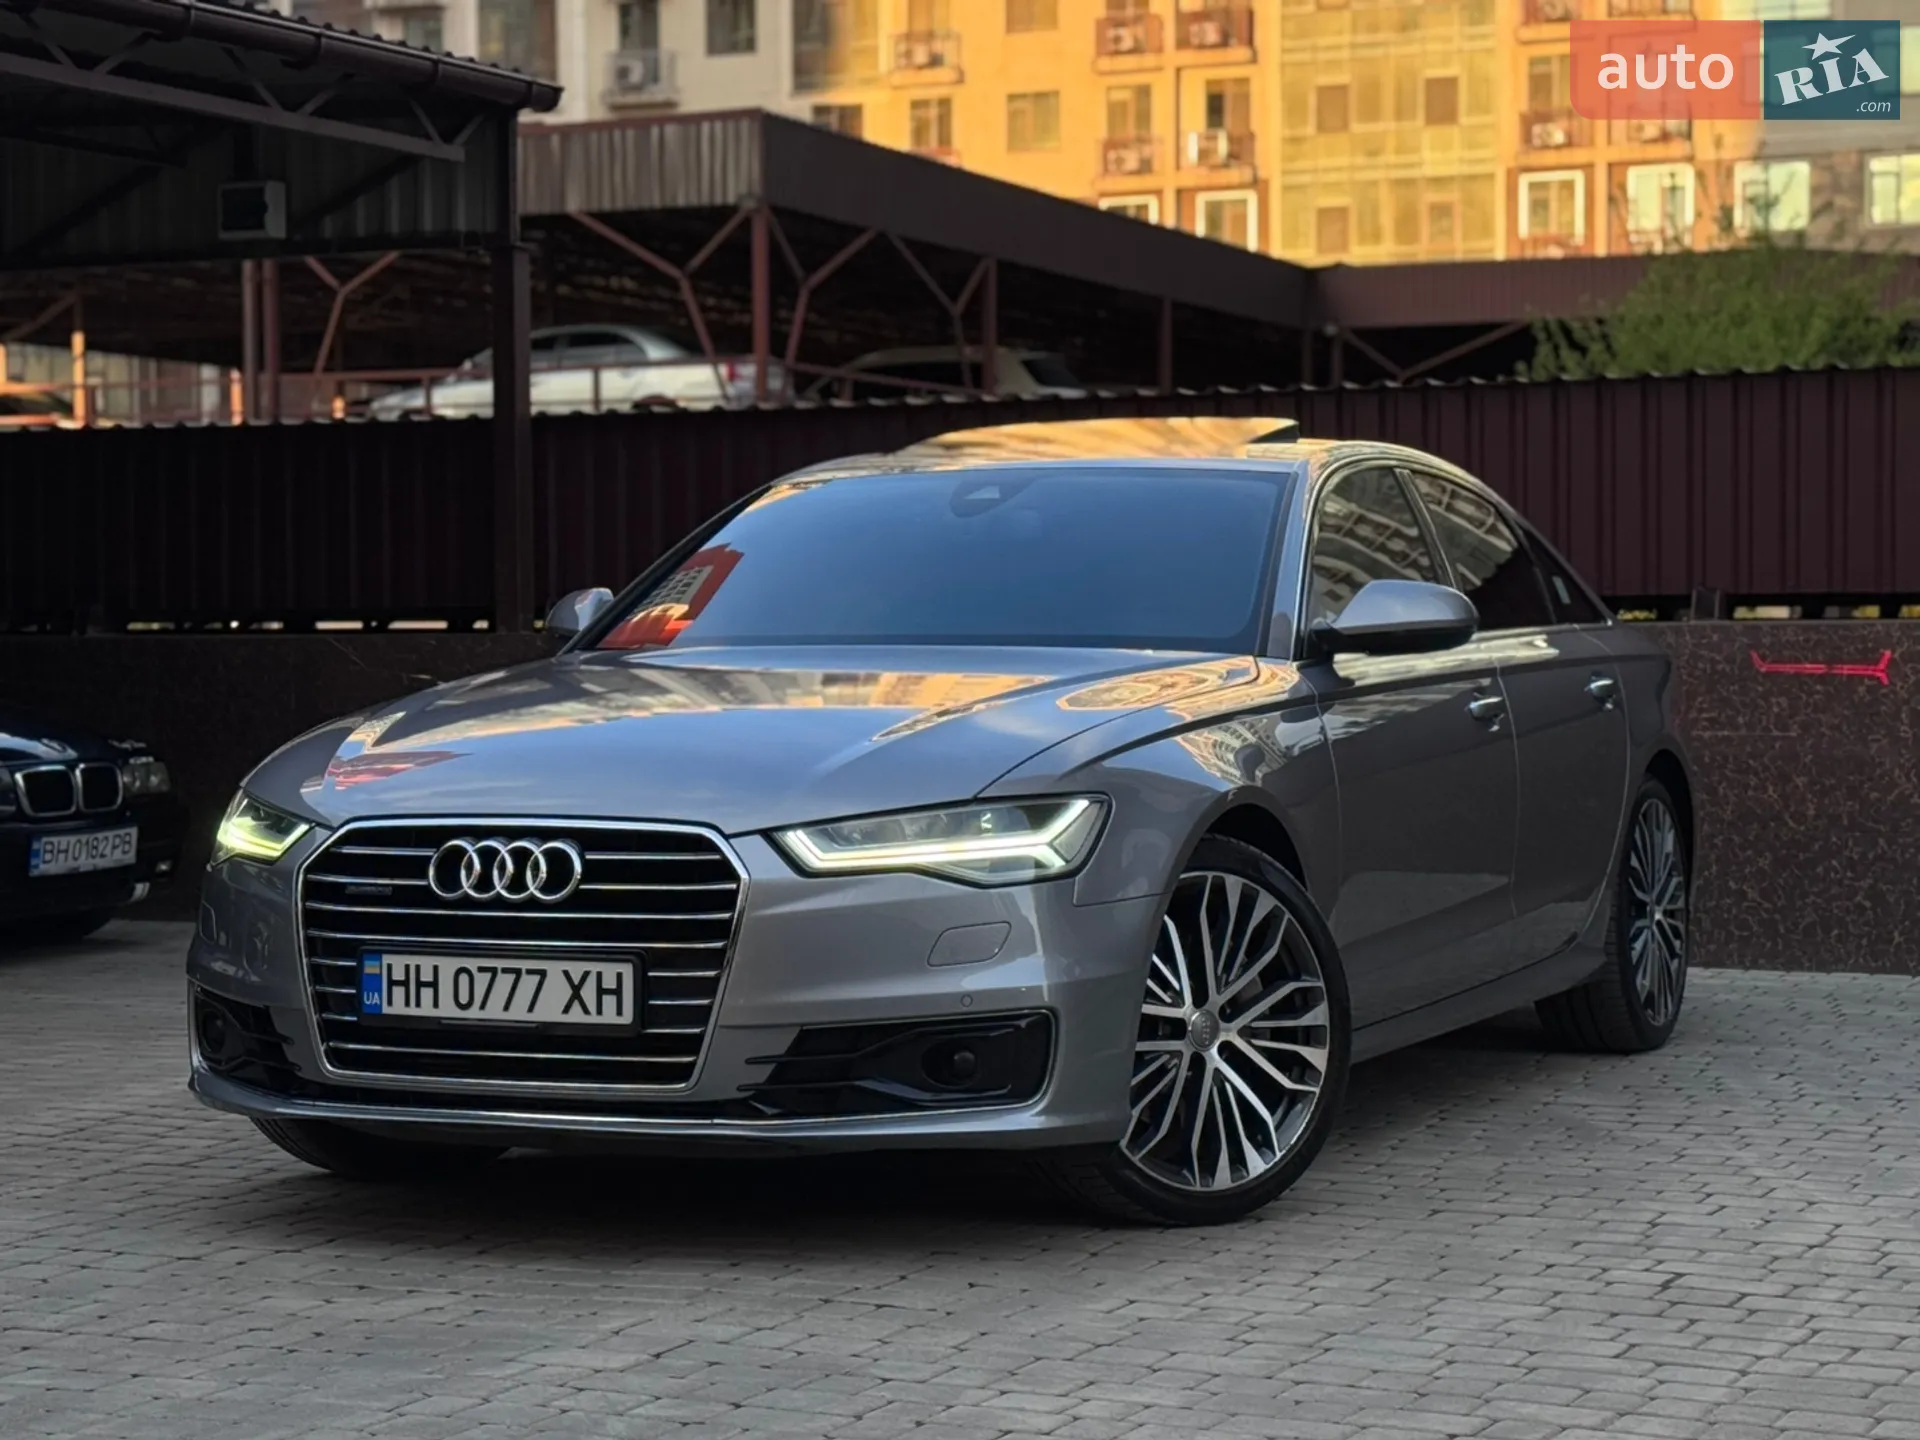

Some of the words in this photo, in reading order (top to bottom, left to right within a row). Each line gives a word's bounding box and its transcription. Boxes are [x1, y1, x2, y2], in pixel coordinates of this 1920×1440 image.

[363, 991, 381, 1006] UA
[386, 962, 440, 1009] HH
[452, 965, 548, 1014] 0777
[561, 969, 624, 1017] XH
